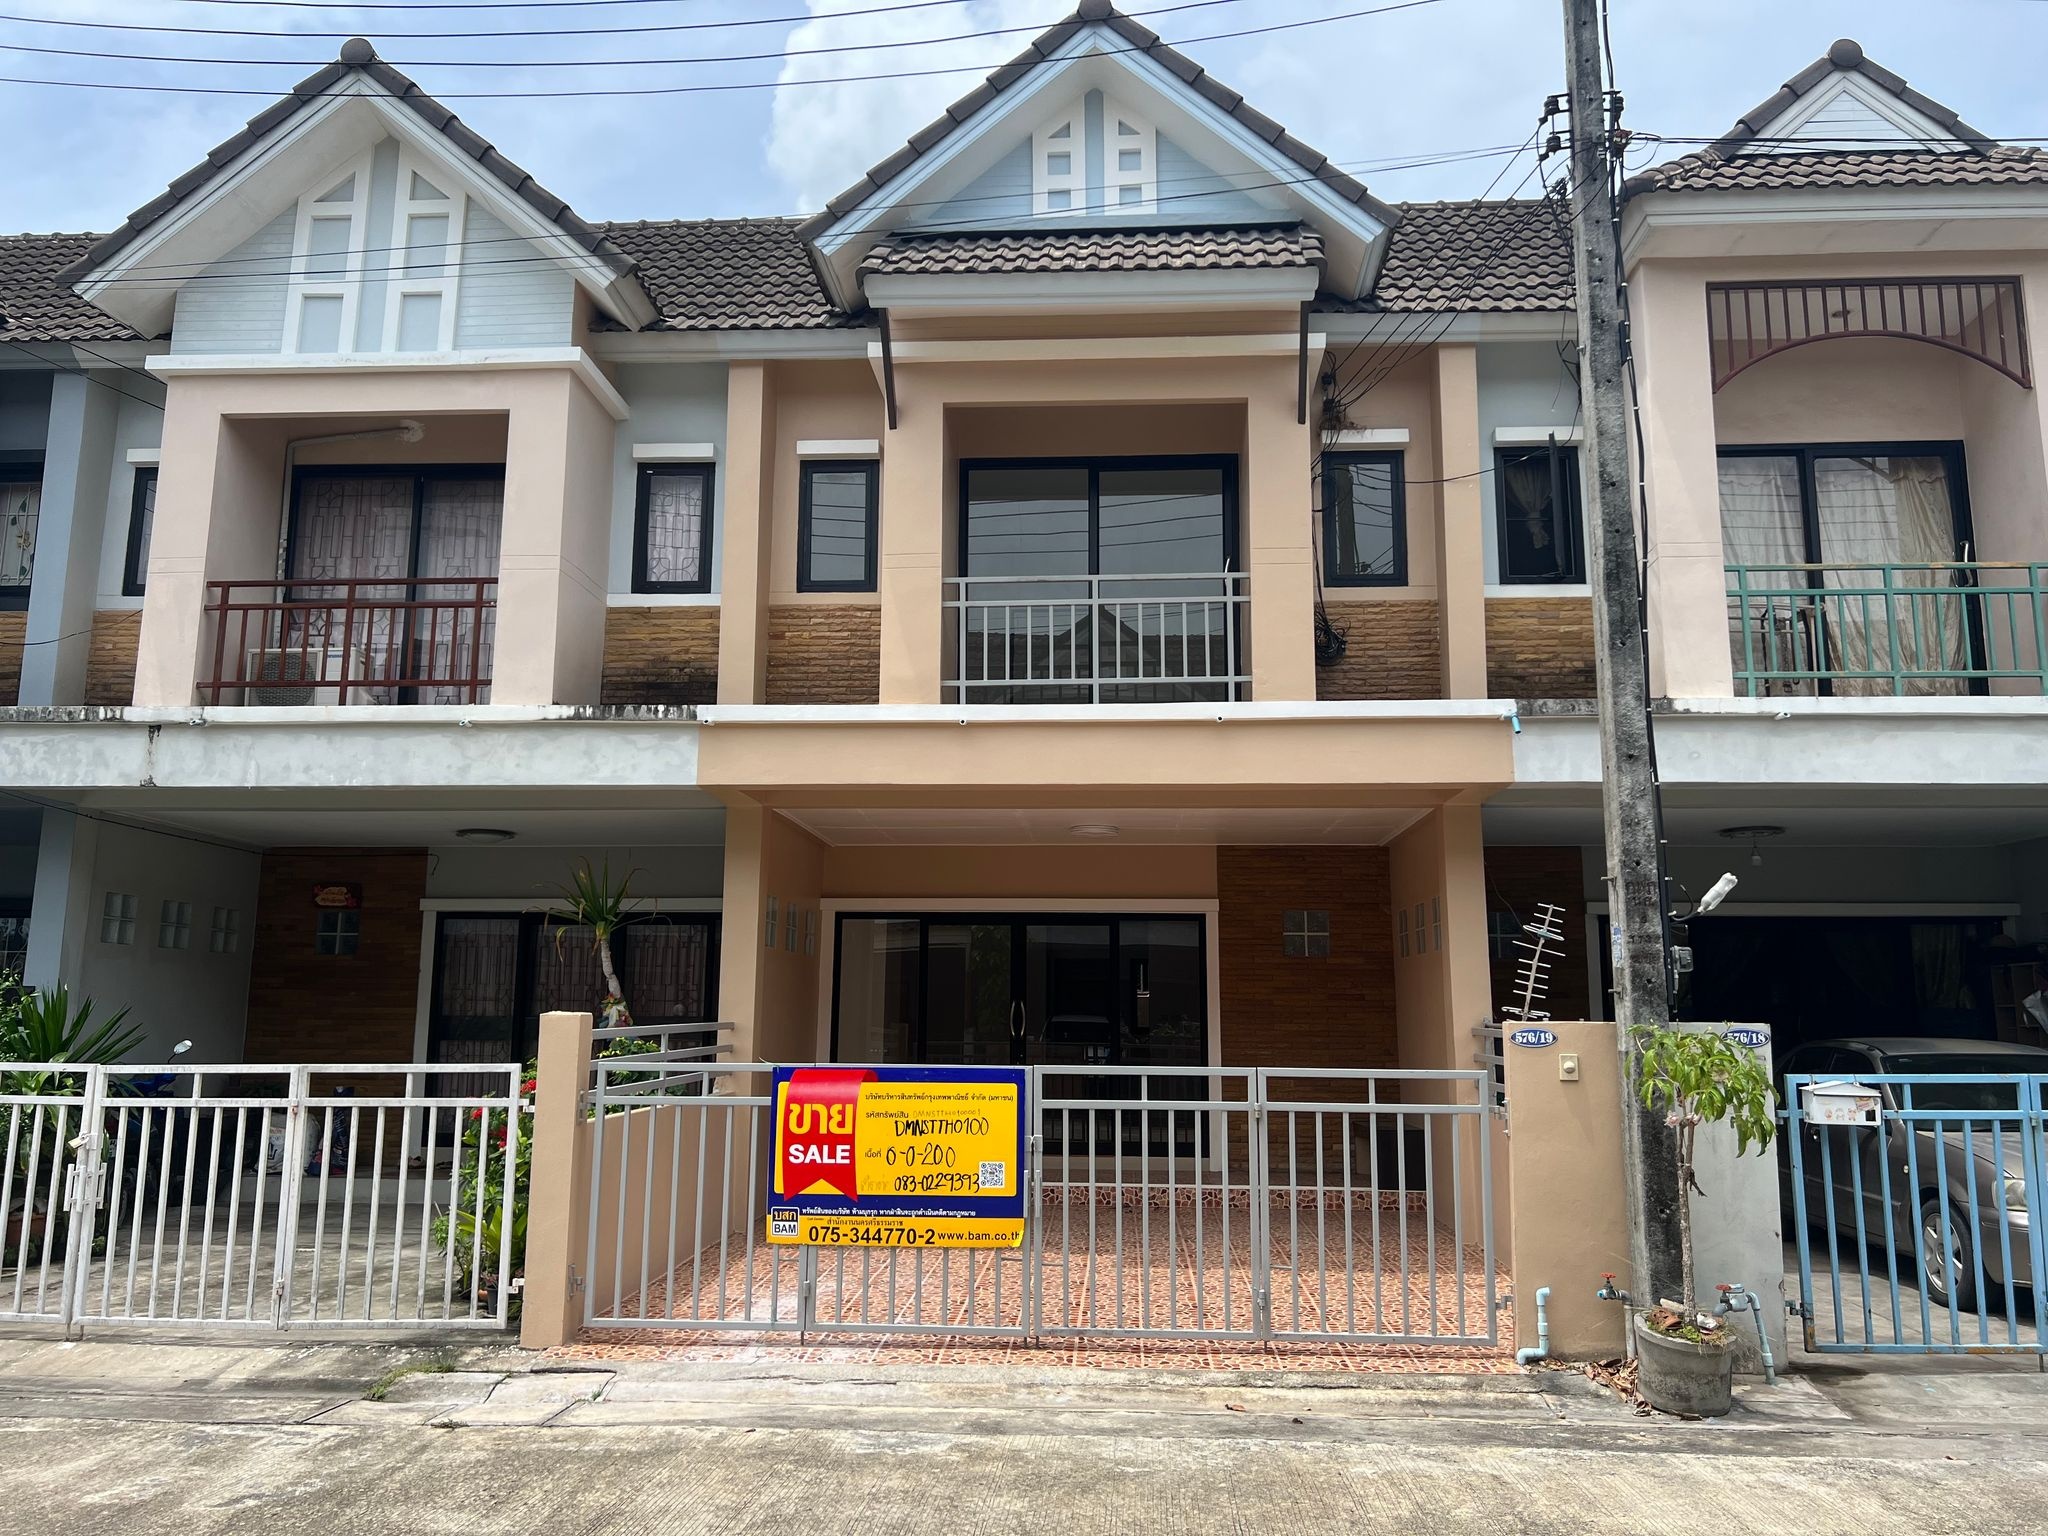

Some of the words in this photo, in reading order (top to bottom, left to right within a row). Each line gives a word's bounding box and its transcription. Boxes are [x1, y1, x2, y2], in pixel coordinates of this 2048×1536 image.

[1515, 1031, 1553, 1044] 576/19
[971, 1093, 986, 1101] จำกัด
[789, 1103, 853, 1135] ขาย
[894, 1117, 989, 1137] DMNSTTH0100
[789, 1144, 851, 1164] SALE
[864, 1148, 881, 1158] เนื้อที่
[894, 1172, 980, 1193] 083-0229393
[774, 1210, 796, 1220] บสก
[774, 1224, 796, 1233] BAM
[809, 1226, 935, 1245] 075-344770-2
[937, 1231, 1020, 1241] www.bam.co.th
